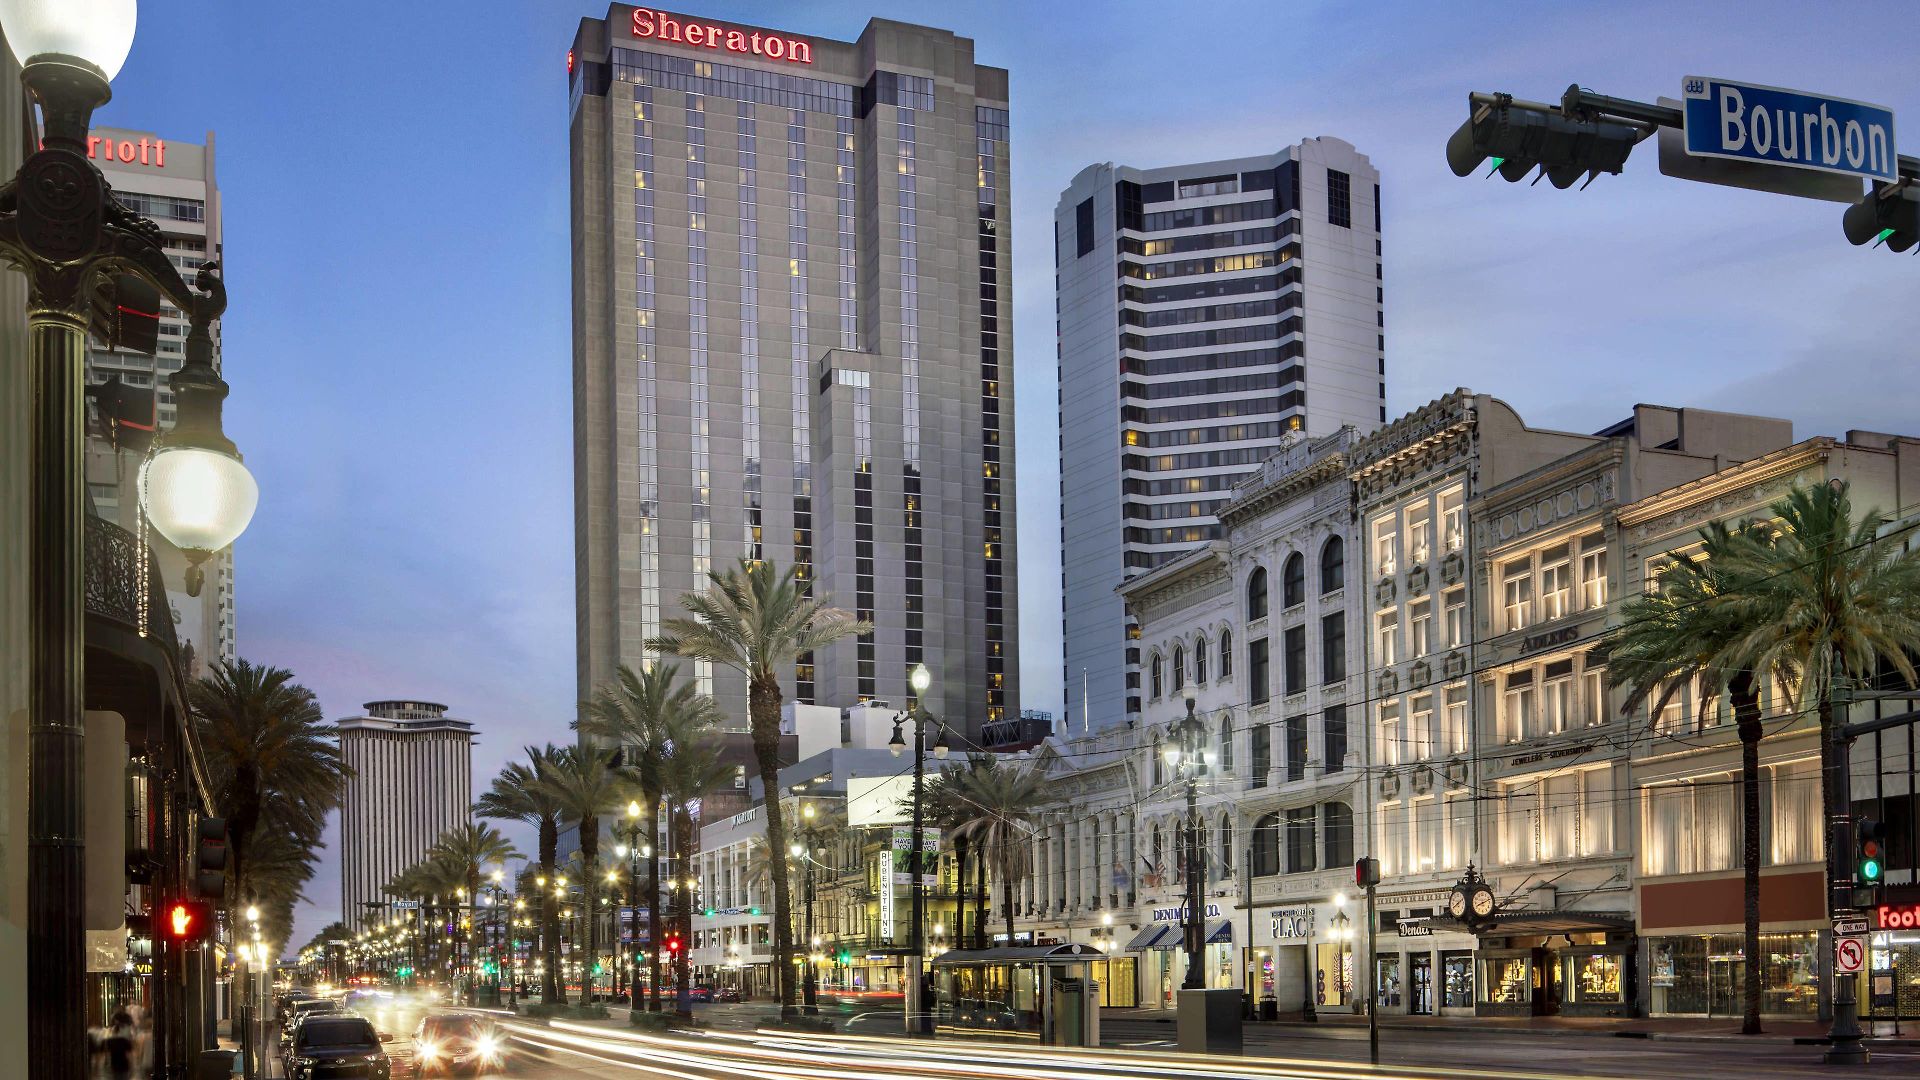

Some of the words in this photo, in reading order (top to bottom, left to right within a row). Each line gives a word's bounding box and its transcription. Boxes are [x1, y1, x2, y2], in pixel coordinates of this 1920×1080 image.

[633, 8, 812, 63] Sheraton
[87, 136, 165, 167] riott
[1719, 86, 1889, 174] Bourbon
[1842, 924, 1853, 932] ONE
[1854, 922, 1866, 931] WAY
